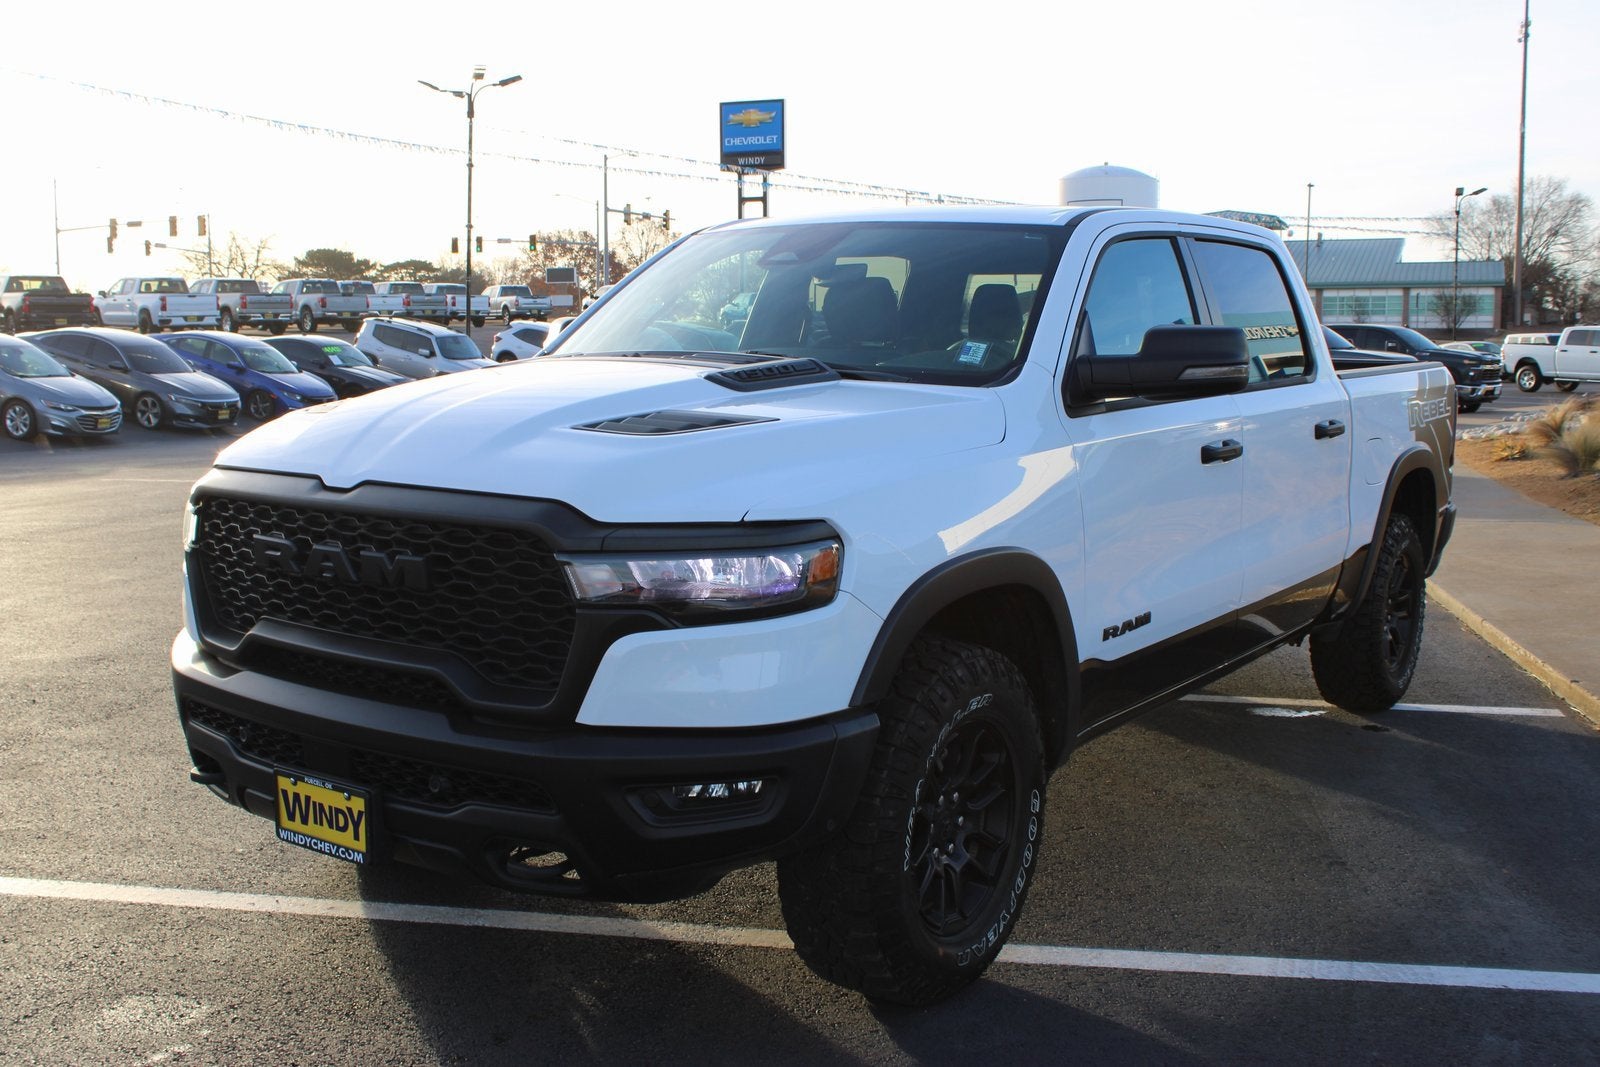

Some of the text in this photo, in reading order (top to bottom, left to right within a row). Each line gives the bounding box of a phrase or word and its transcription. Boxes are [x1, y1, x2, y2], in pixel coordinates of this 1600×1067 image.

[725, 135, 777, 145] CHEVROLET
[738, 156, 765, 165] WINDY
[1408, 397, 1452, 428] REBEL
[252, 534, 428, 590] RAM
[1102, 611, 1152, 642] RAM
[281, 788, 364, 842] WINDY
[279, 829, 364, 864] WINDYCHEV.COM
[957, 789, 1041, 967] GOODYEAR
